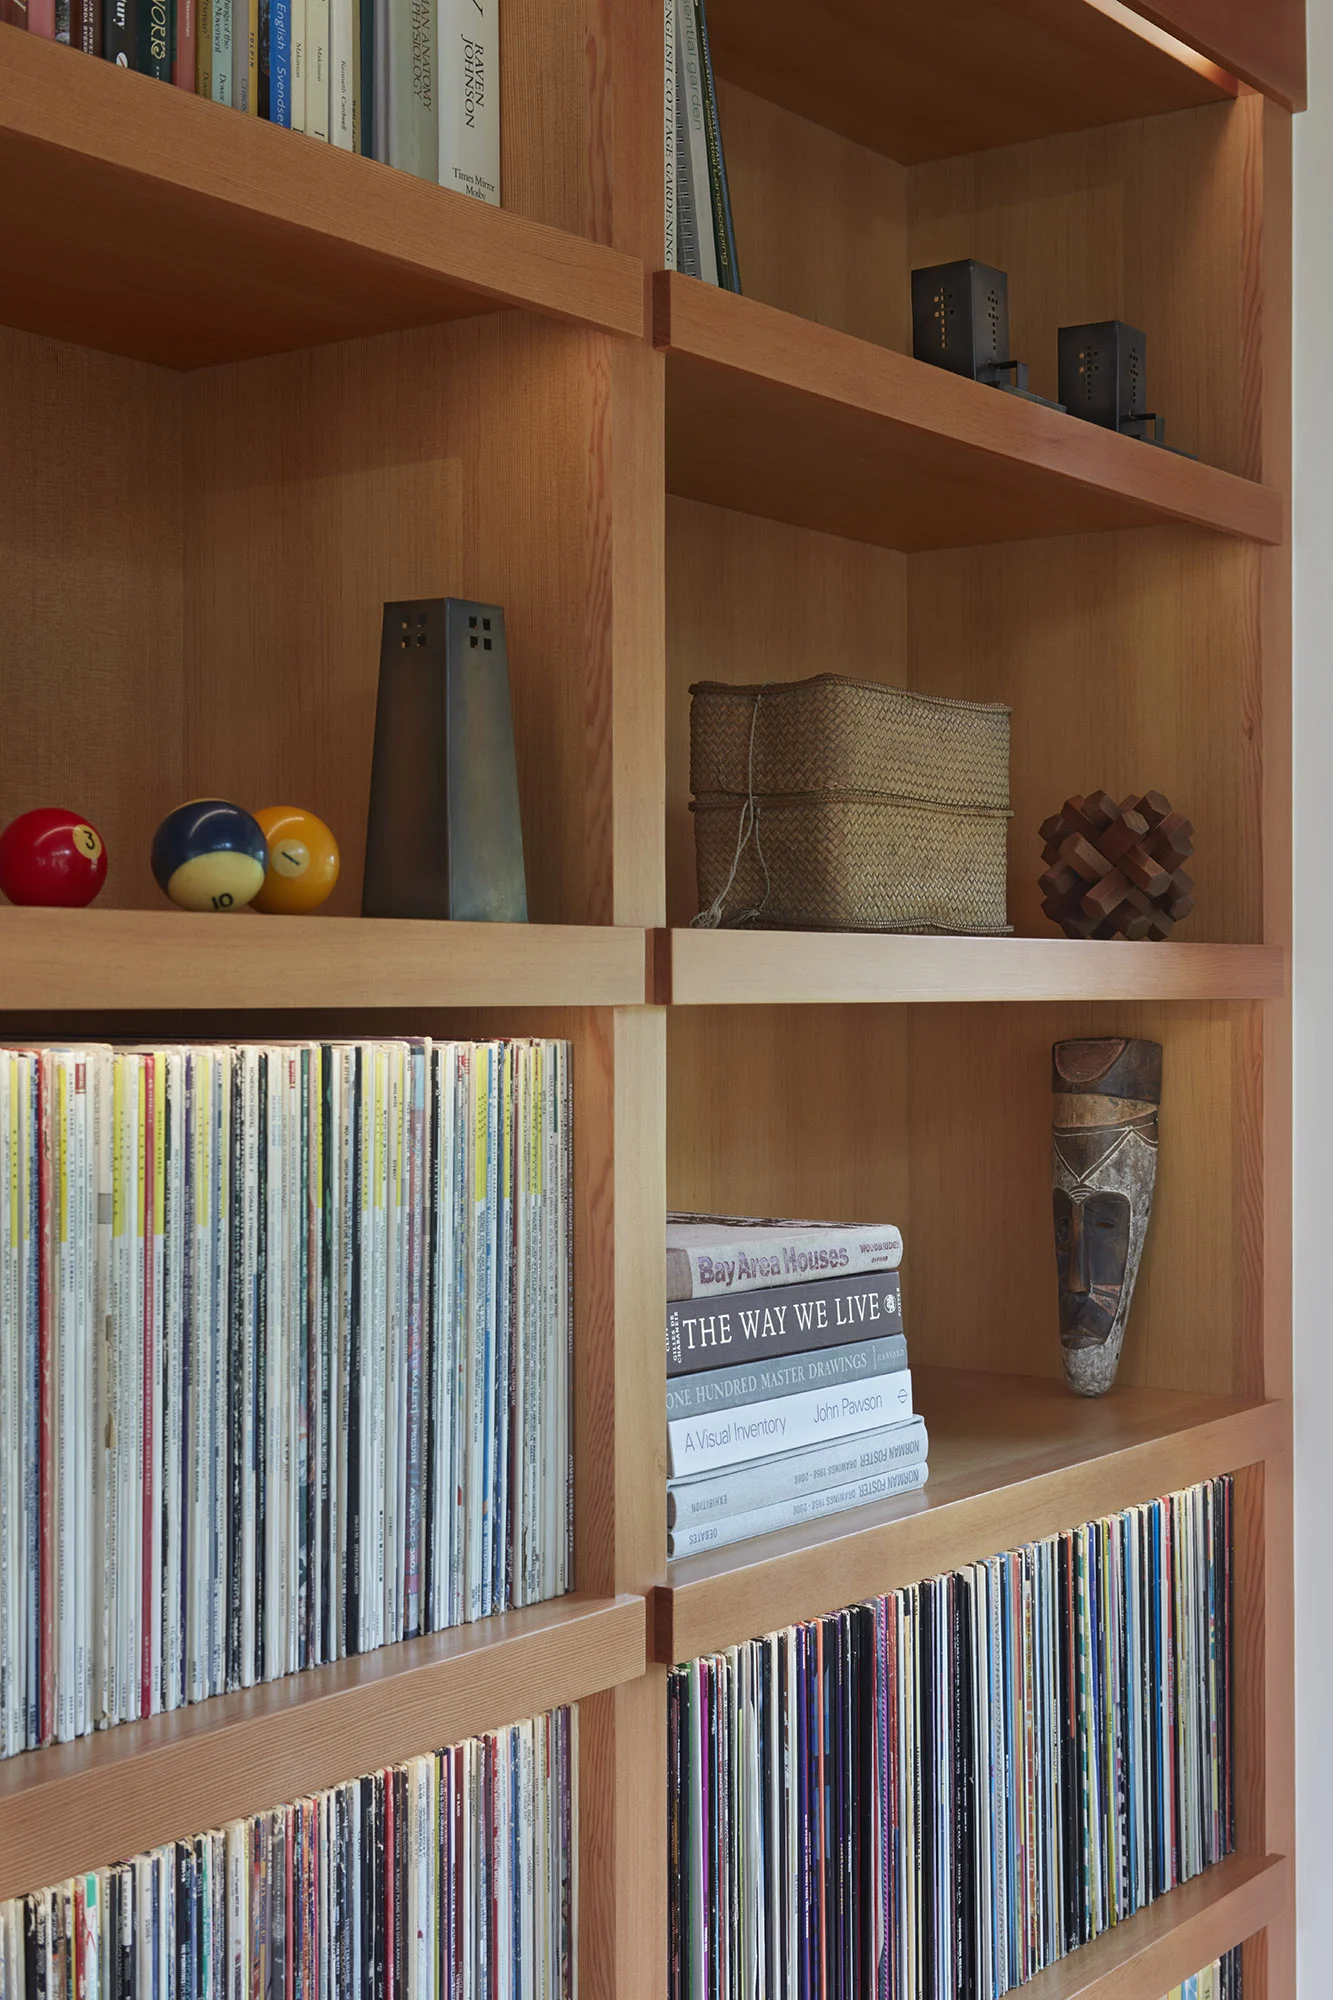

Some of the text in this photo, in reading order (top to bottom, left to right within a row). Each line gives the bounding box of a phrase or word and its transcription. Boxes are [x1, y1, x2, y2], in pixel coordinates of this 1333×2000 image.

[274, 2, 287, 50] English
[411, 2, 422, 101] PHYSIOLOGY
[219, 73, 227, 101] Dover
[421, 32, 432, 113] ANATOMY
[460, 33, 475, 129] JOHNSON
[474, 42, 485, 108] RAVEN
[686, 61, 703, 132] garden
[664, 0, 675, 263] ENGLISH COTTAGE GARDENING
[452, 166, 496, 194] Times Mirror
[465, 184, 487, 201] Mosby
[713, 167, 729, 266] Landscaping
[82, 830, 96, 850] 3
[210, 892, 235, 911] 10
[414, 1123, 422, 1186] PROKOFIEV
[414, 1193, 422, 1235] ROMEO
[414, 1236, 422, 1262] AND
[698, 1254, 736, 1287] Bay
[737, 1251, 782, 1281] Area
[782, 1246, 850, 1274] Houses
[413, 1264, 421, 1301] JULIET
[674, 1311, 682, 1364] CHABANEIX
[682, 1292, 881, 1350] THE WAY WE LIVE
[666, 1352, 868, 1410] ONE HUNDRED MASTER DRAWINGS
[813, 1393, 884, 1424] John Pawson
[410, 1423, 418, 1464] PREVIN
[684, 1415, 787, 1453] A Visual Inventory
[888, 1439, 921, 1460] NORMAN
[859, 1449, 889, 1467] FOSTER
[858, 1478, 888, 1497] FOSTER
[886, 1469, 920, 1489] NORMAN
[691, 1494, 728, 1514] EXHIBITION
[689, 1527, 719, 1546] DEBATES
